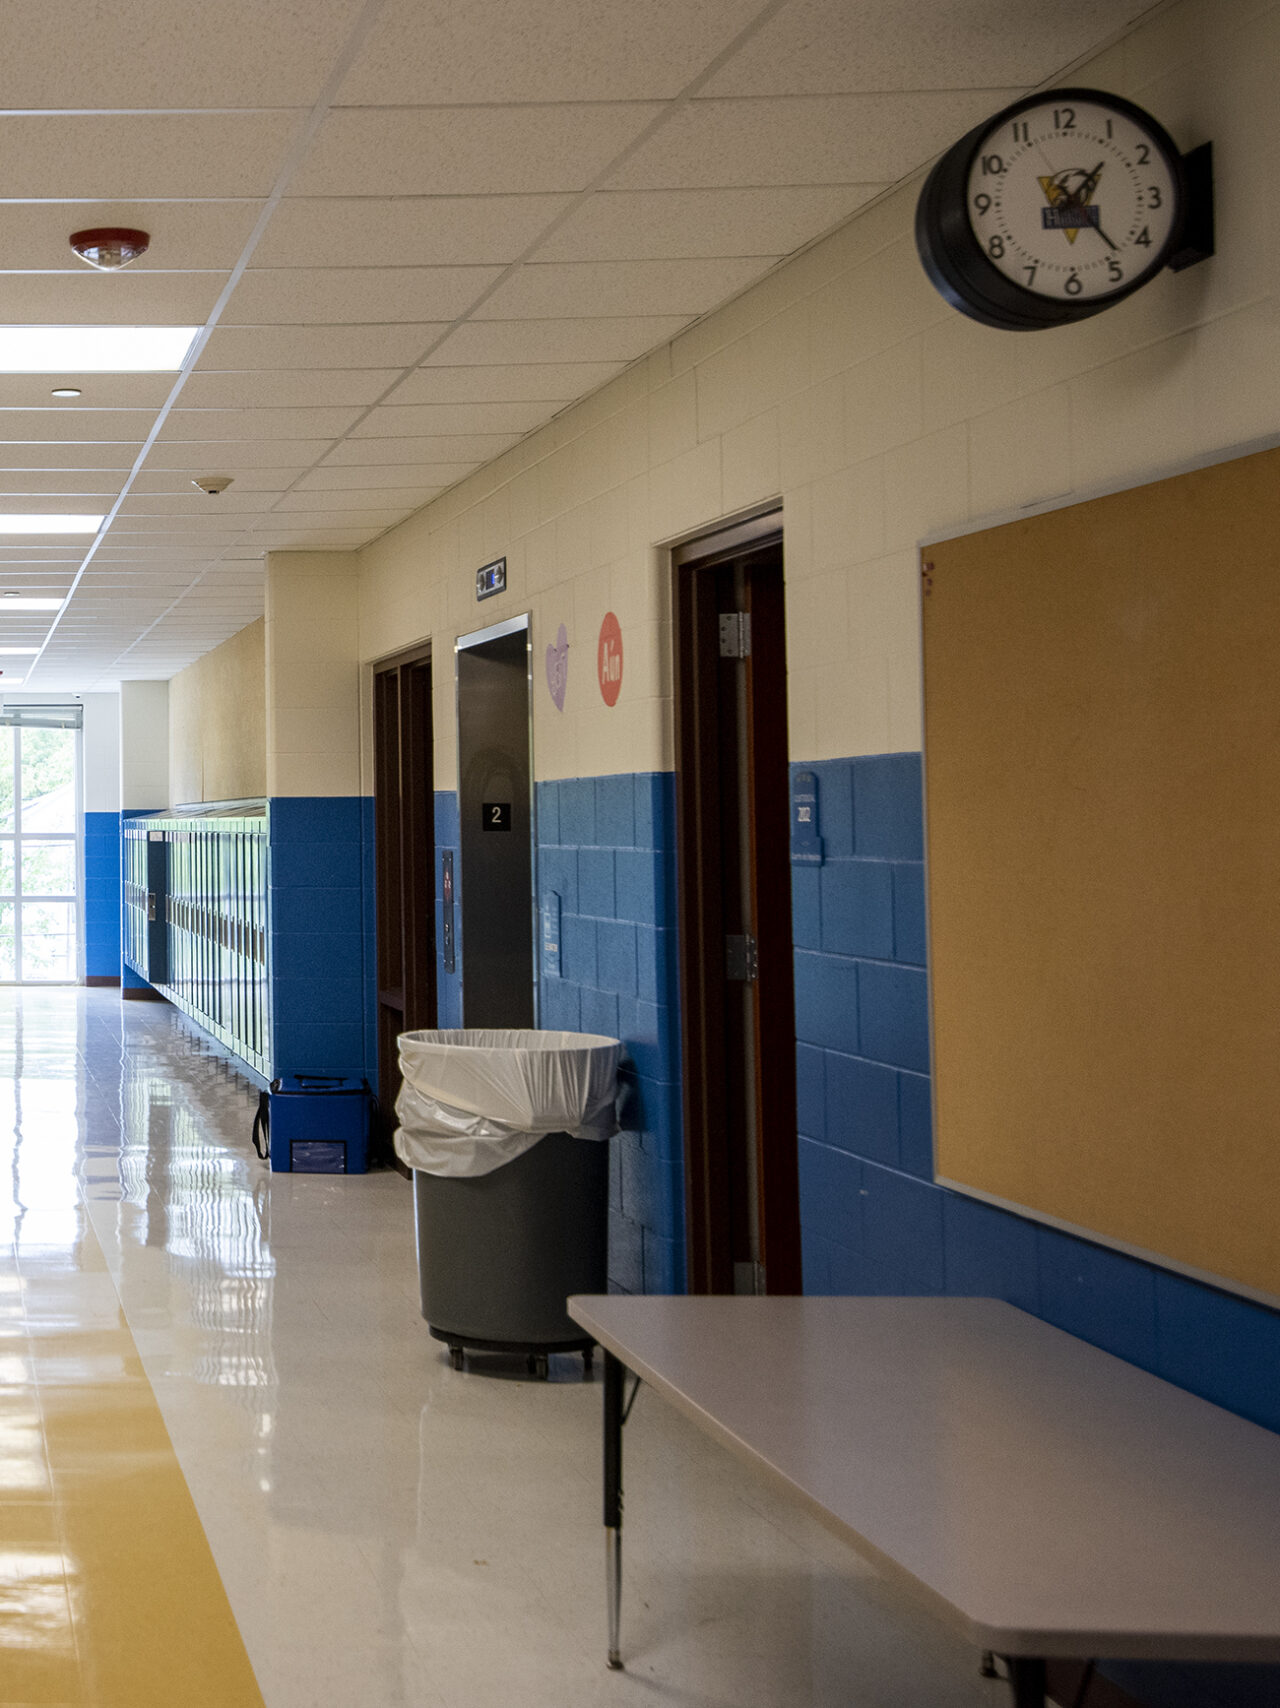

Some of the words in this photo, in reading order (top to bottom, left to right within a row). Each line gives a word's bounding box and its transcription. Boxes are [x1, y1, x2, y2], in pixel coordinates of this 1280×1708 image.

[1053, 108, 1076, 129] 12
[1106, 119, 1113, 139] 1
[1012, 122, 1029, 142] 11
[982, 154, 1003, 175] 10
[1135, 144, 1150, 165] 2
[974, 193, 991, 215] 9
[1147, 186, 1162, 209] 3
[989, 235, 1005, 259] 8
[1134, 225, 1152, 248] 4
[1022, 266, 1037, 286] 7
[1108, 261, 1123, 282] 5
[1064, 272, 1082, 295] 6
[491, 807, 502, 823] 2
